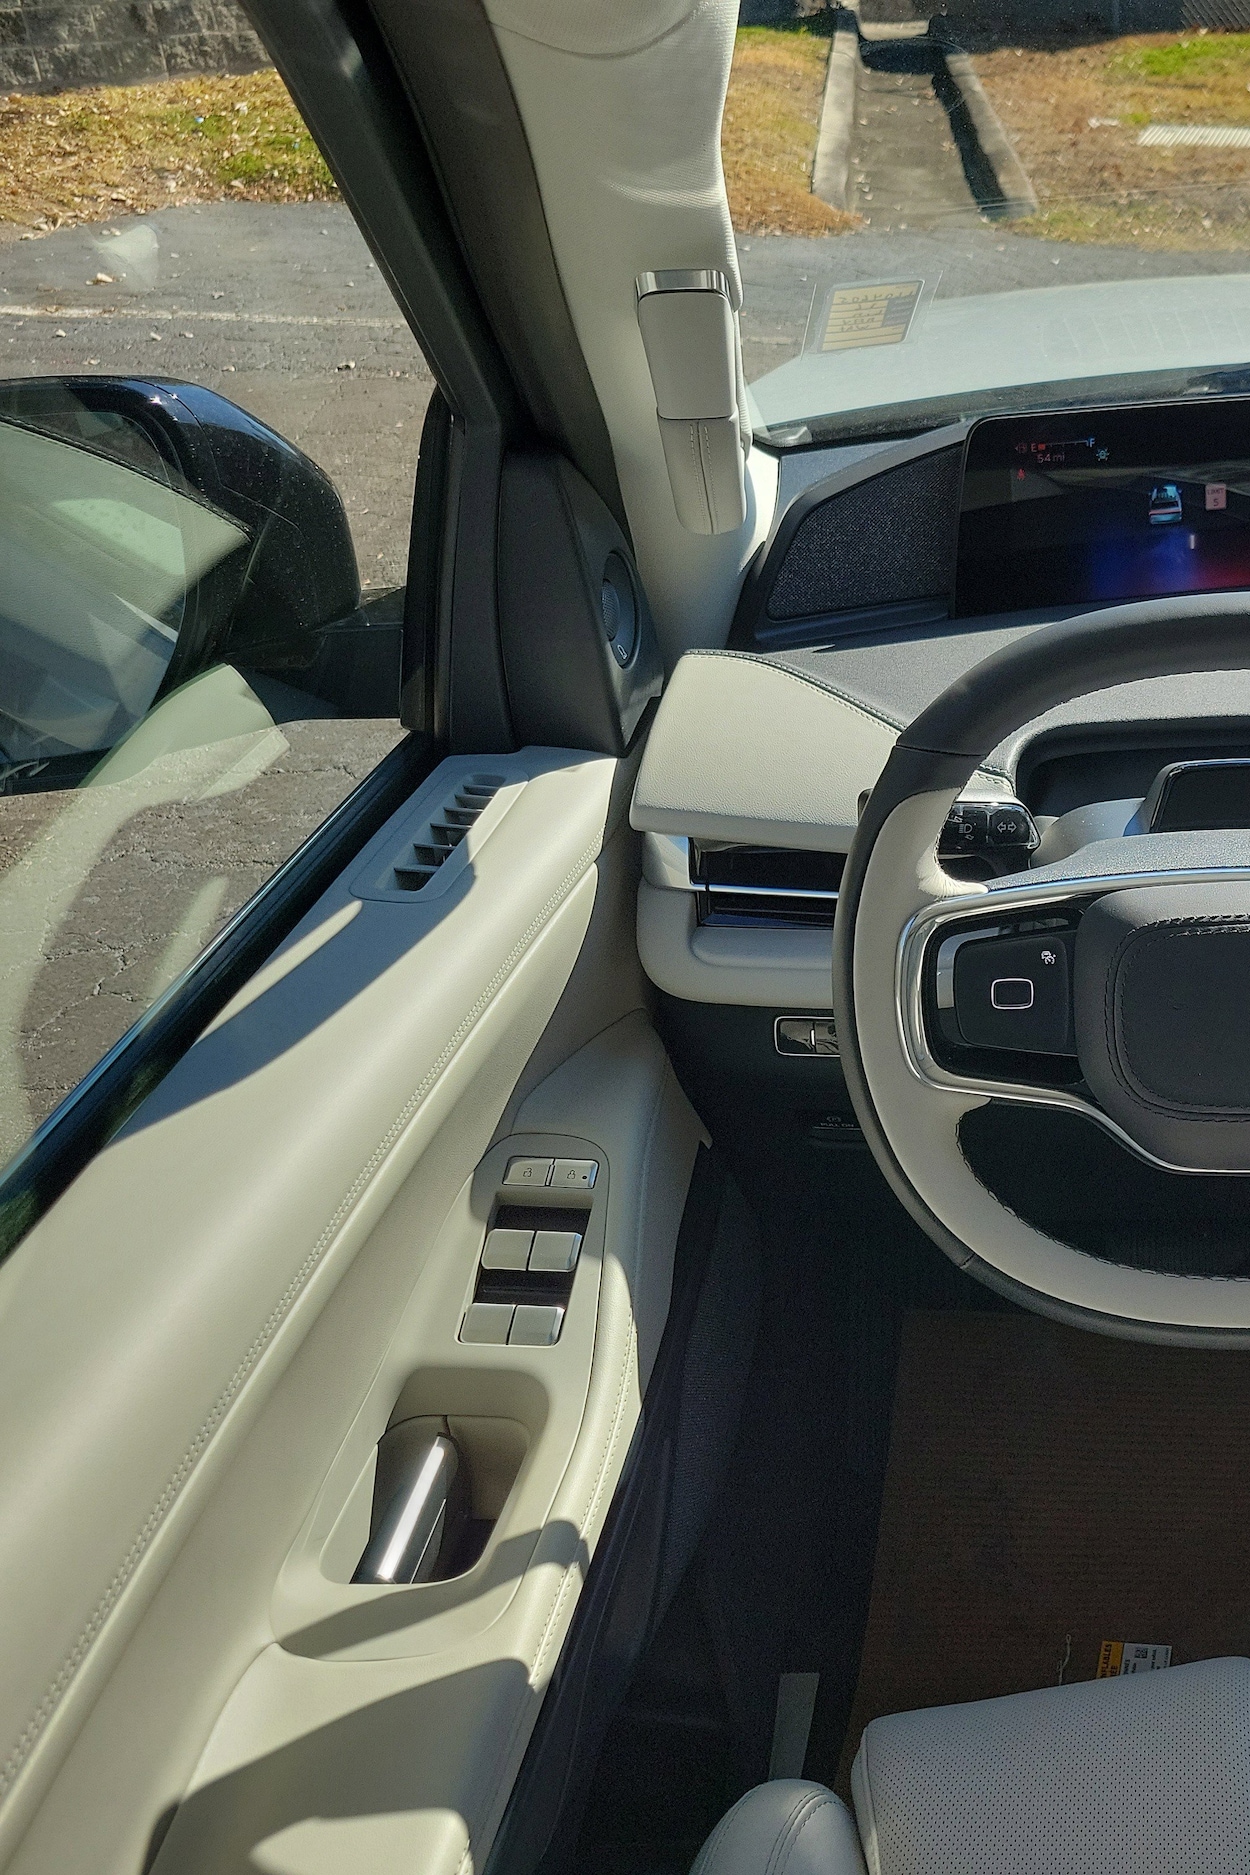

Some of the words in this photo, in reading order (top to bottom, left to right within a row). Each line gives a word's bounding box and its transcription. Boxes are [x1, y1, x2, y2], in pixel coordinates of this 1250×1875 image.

[1030, 443, 1038, 453] E
[1088, 438, 1096, 448] F
[1037, 454, 1051, 464] 54
[1053, 453, 1066, 463] mi
[1213, 498, 1220, 507] 5
